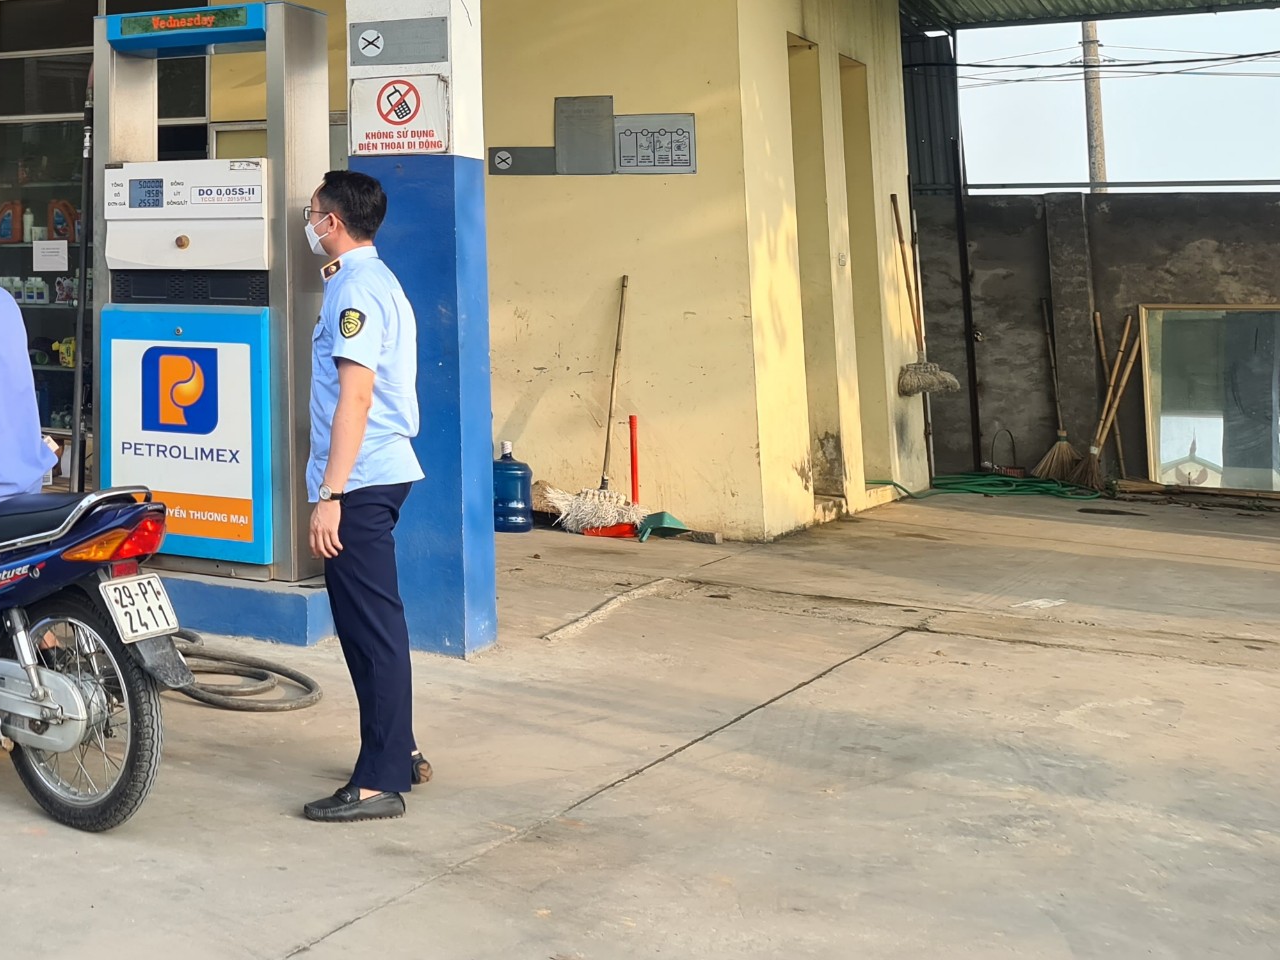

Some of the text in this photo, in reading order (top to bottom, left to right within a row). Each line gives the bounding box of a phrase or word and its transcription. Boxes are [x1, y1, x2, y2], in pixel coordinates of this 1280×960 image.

[152, 13, 216, 30] Wednesday
[365, 127, 435, 140] KHÔNG SỬ DỤNG
[358, 139, 443, 152] ĐIỆN THOẠI DI ĐỘNG
[198, 187, 255, 197] DO 0,05S-II
[121, 441, 240, 464] PETROLIMEX
[166, 505, 249, 527] YỀN THƯƠNG MẠI
[113, 580, 160, 609] 29-P1
[124, 604, 171, 634] 2411
